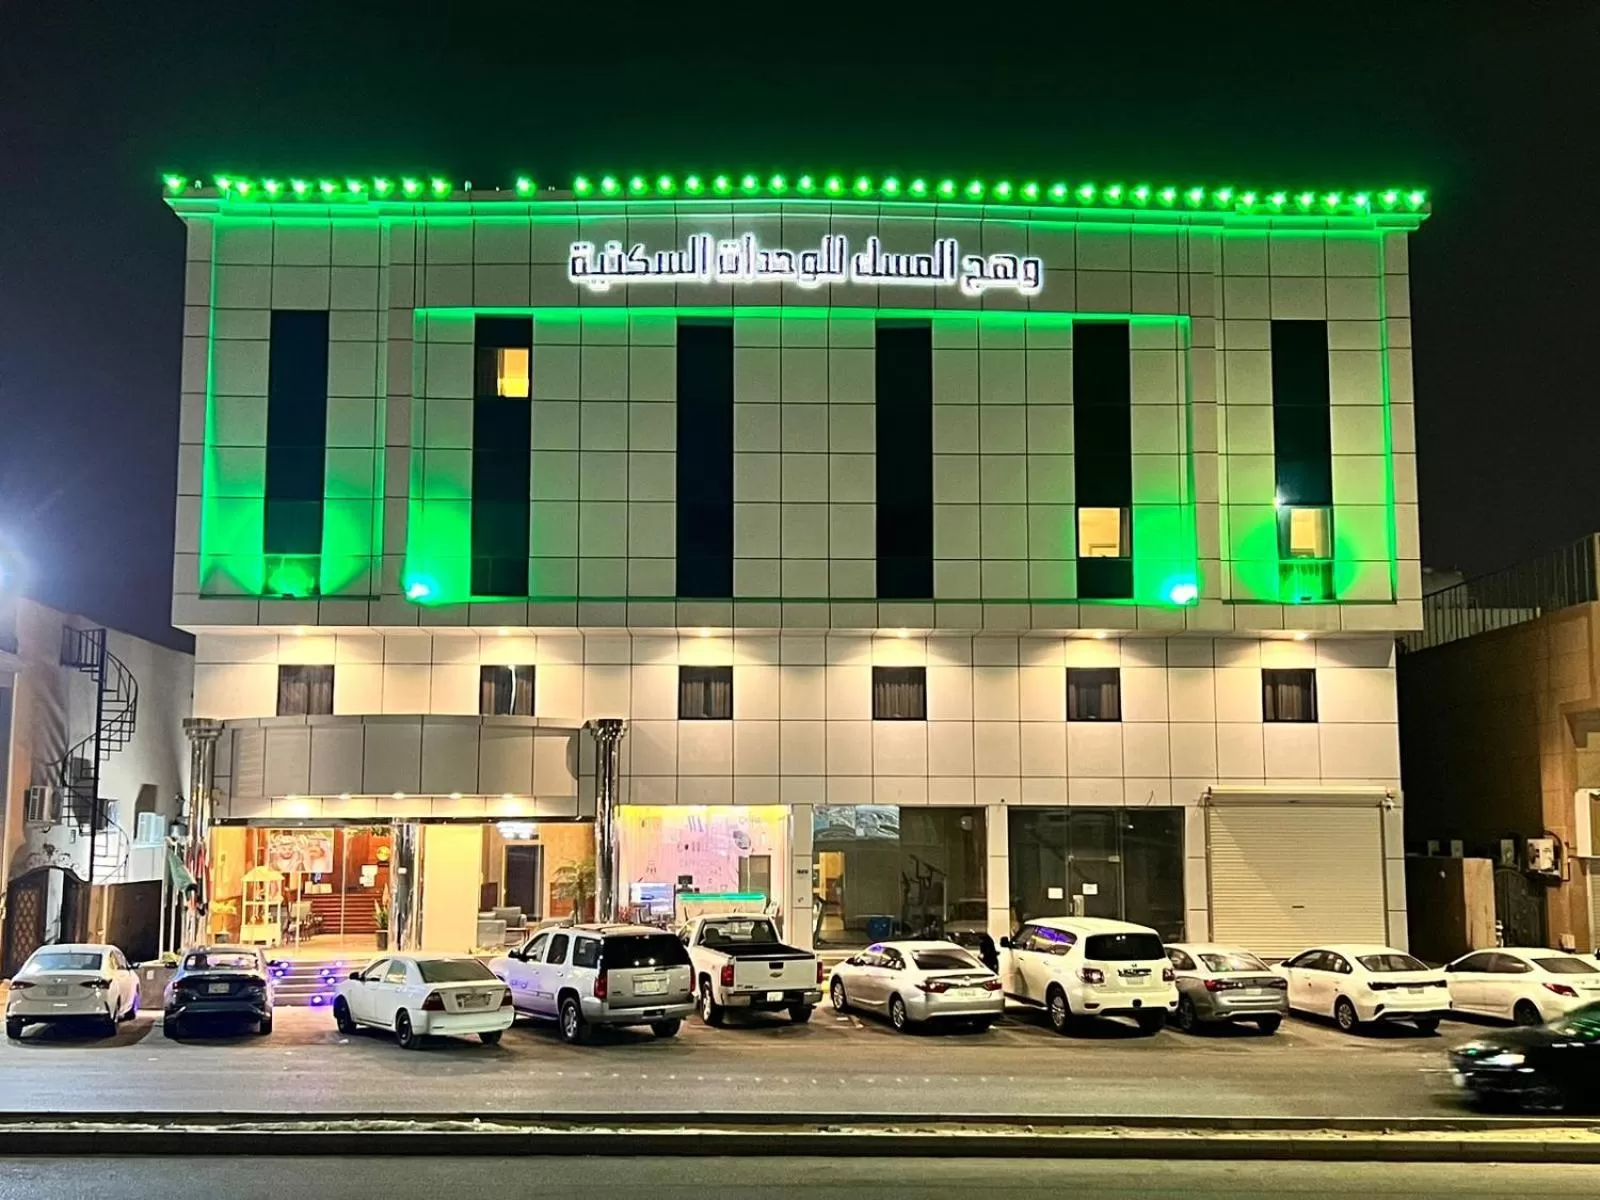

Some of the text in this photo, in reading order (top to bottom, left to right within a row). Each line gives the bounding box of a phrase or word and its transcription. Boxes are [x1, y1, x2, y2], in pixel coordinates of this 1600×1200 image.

[569, 234, 1042, 291] وهج المسك للوحدات السكنية
